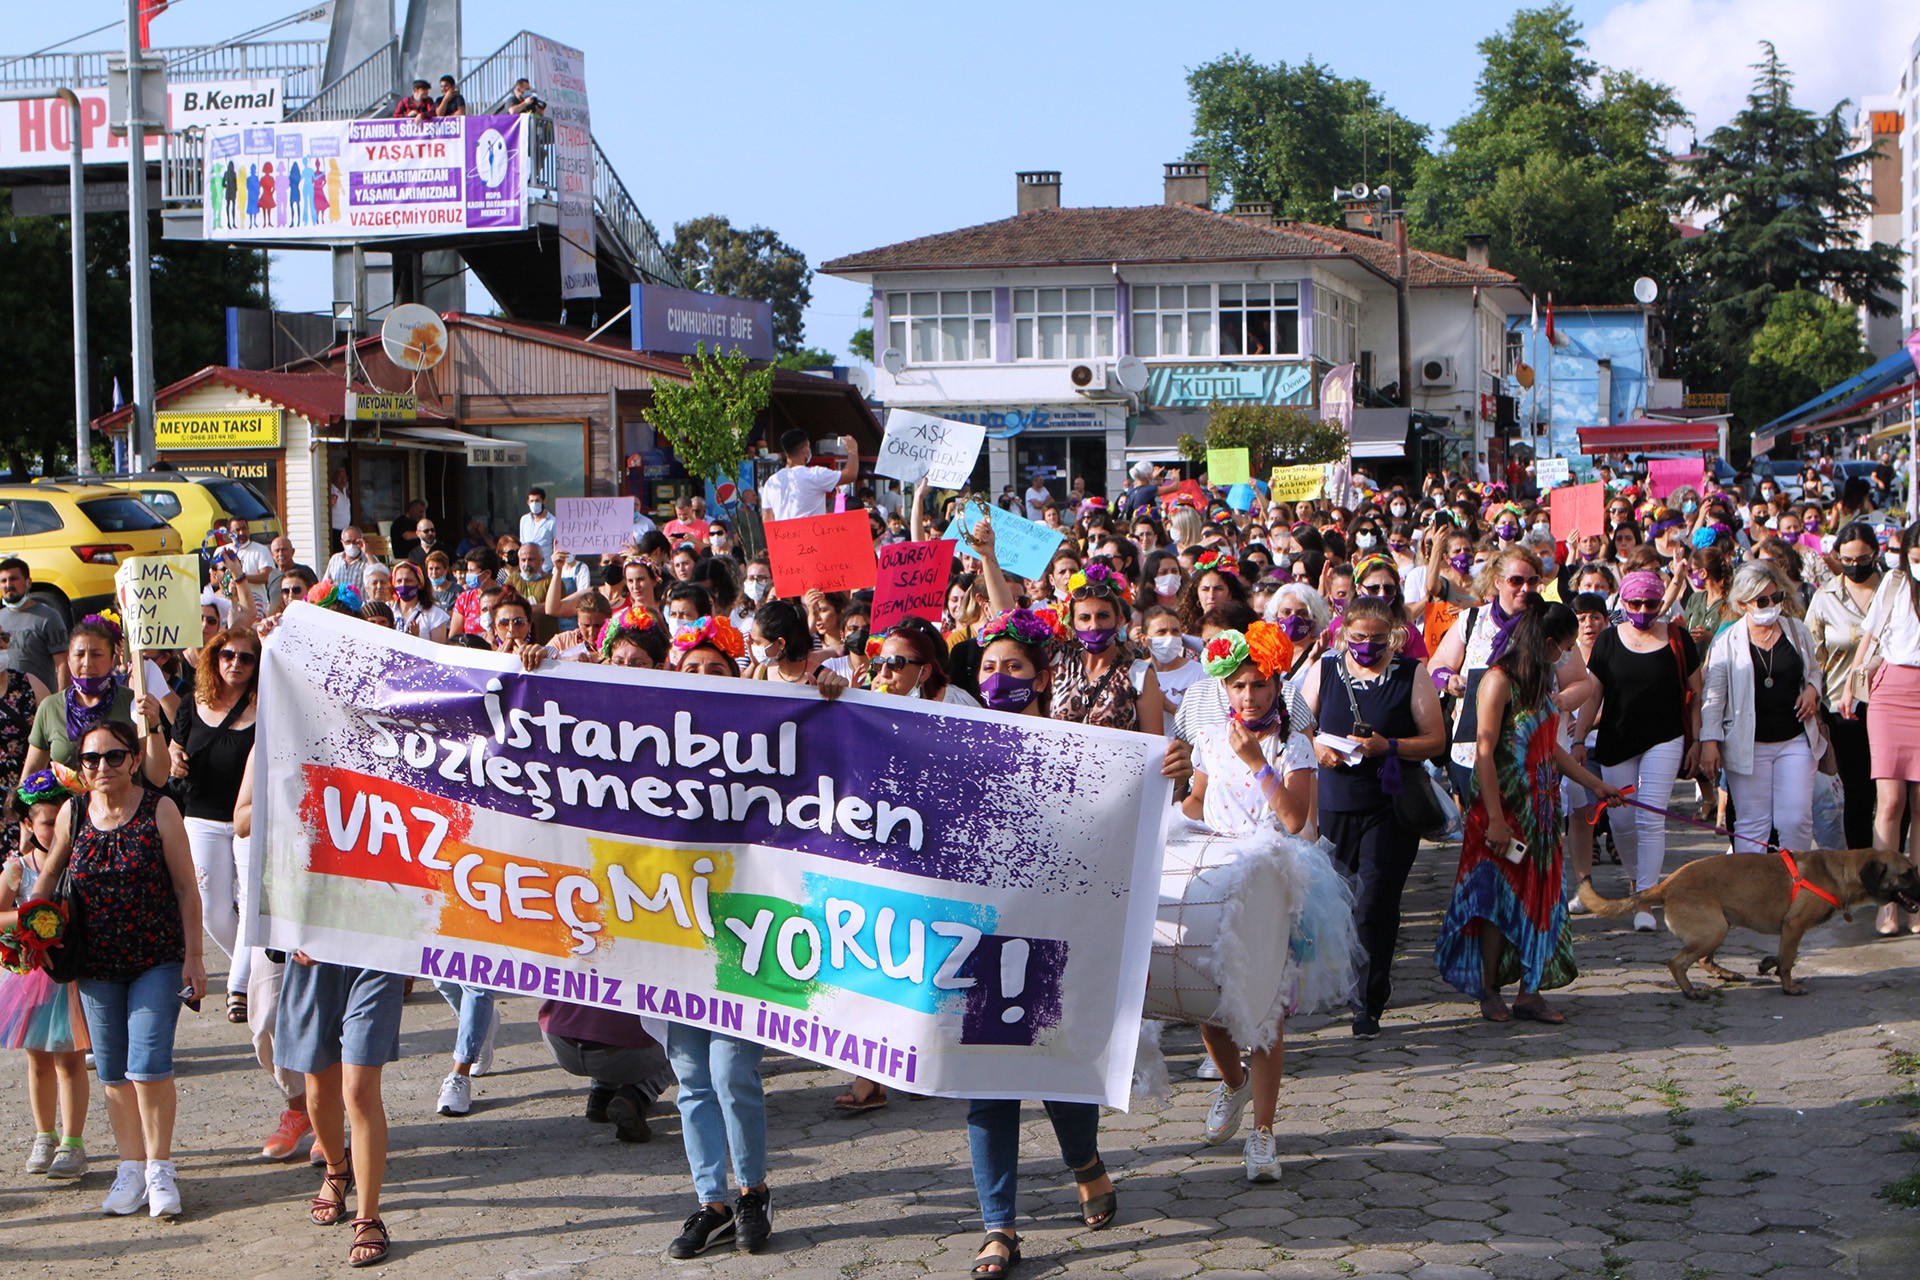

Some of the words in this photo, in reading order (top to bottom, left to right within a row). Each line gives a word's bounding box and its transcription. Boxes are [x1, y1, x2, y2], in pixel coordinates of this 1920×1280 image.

[184, 88, 275, 112] B.Kemal
[349, 121, 397, 139] İSTANBUL
[365, 143, 446, 162] YAŞATIR
[363, 168, 449, 185] HAKLARIMIZDAN
[355, 185, 457, 205] YAŞAMLARIMIZDAN
[350, 208, 463, 228] VAZGEÇMİYORUZ
[667, 308, 727, 336] CUMHURİYET
[730, 312, 753, 340] BÜFE
[357, 397, 392, 410] MEYDAN
[394, 396, 416, 410] TAKSİ
[160, 420, 219, 434] MEYDAN
[223, 417, 262, 433] TAKSİ
[911, 424, 952, 447] AŞK
[231, 462, 268, 478] TAKSİ
[881, 545, 938, 570] ÖLDÜREN
[133, 586, 167, 599] VAR
[484, 677, 798, 776] İstanbul
[361, 711, 925, 852] Sözleşmesinden
[420, 946, 623, 1006] KARADENİZ
[636, 983, 744, 1031] KADIN
[755, 1001, 918, 1083] İNSİYATİFİ
